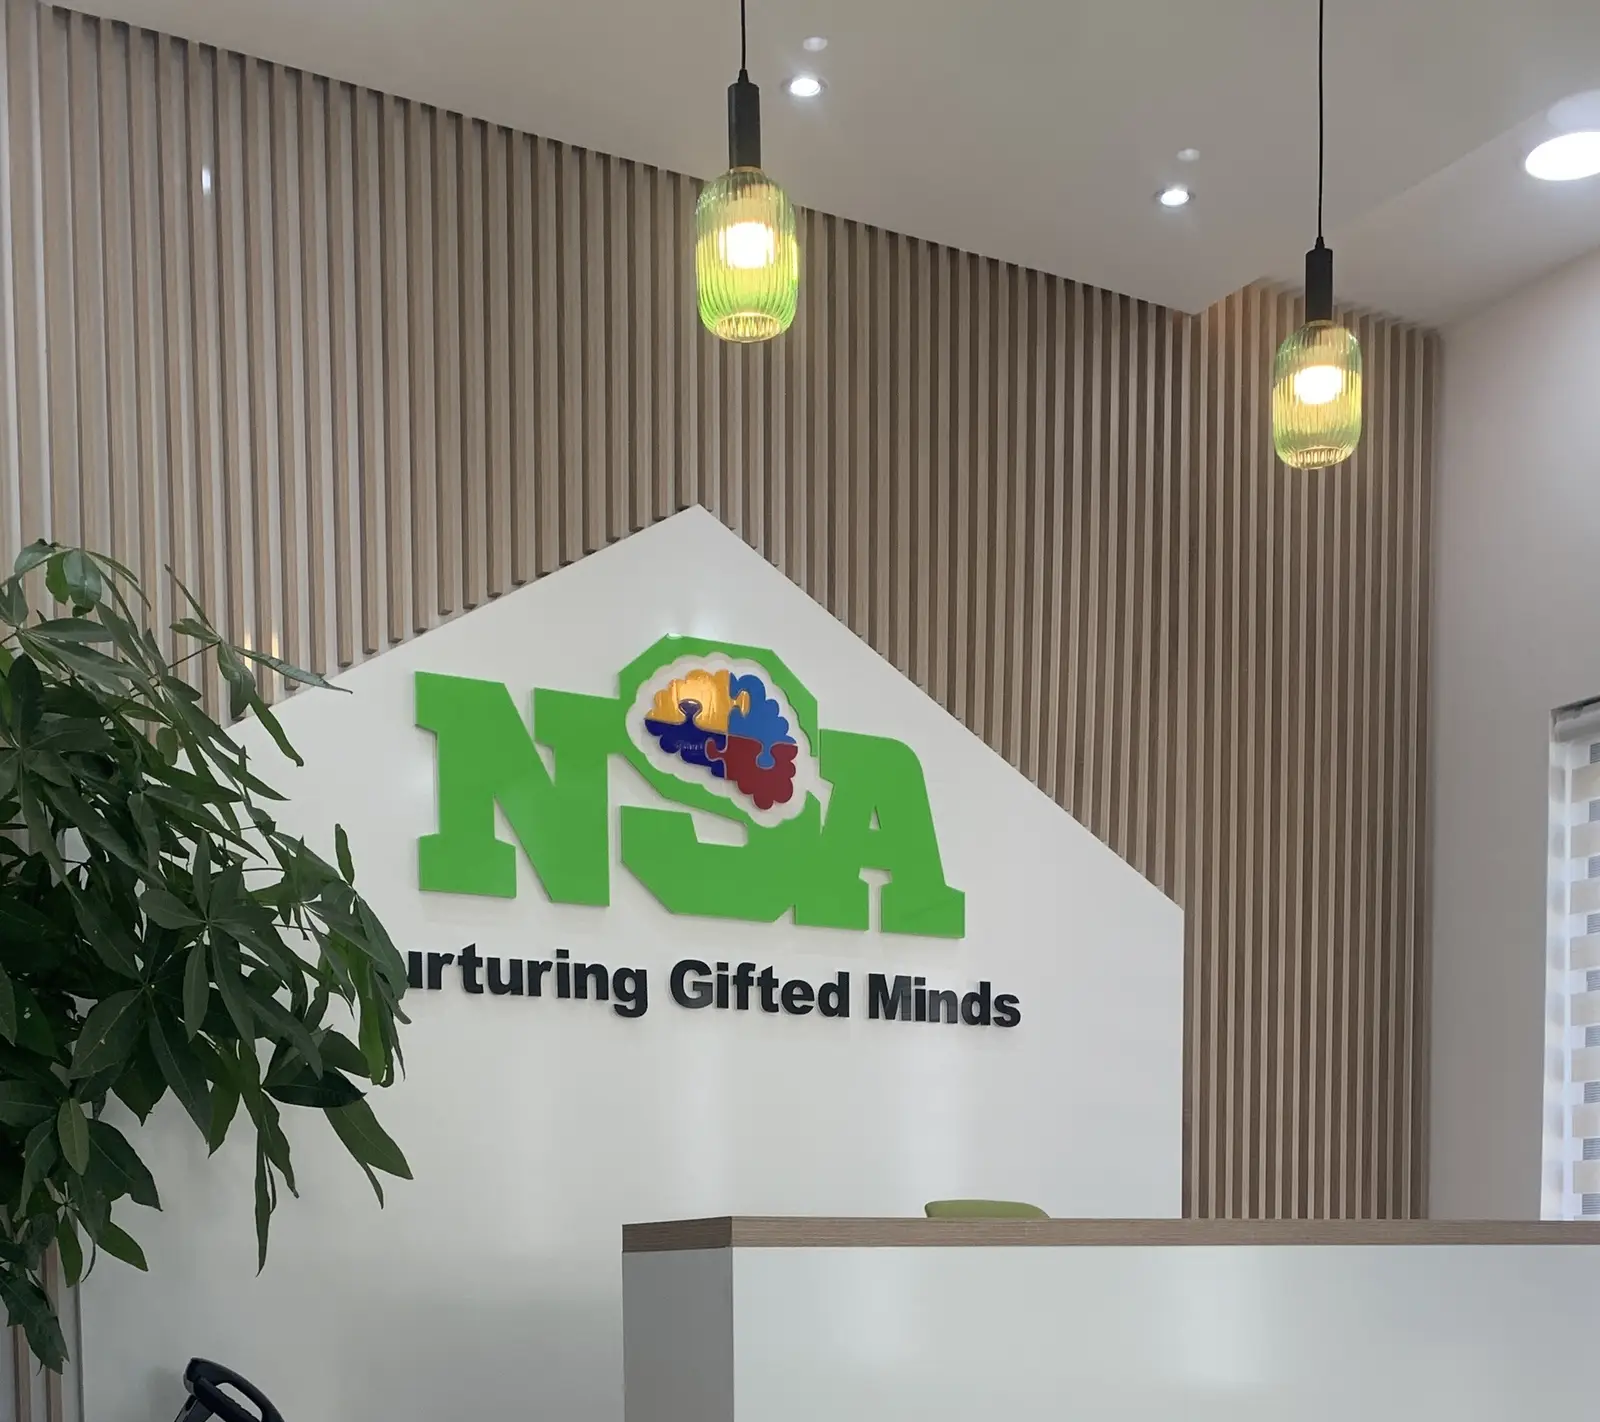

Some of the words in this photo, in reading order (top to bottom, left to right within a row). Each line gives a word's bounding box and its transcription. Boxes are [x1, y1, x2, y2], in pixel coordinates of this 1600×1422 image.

[414, 633, 965, 938] NSA
[406, 943, 649, 1018] rturing
[669, 959, 850, 1018] Gifted
[867, 973, 1022, 1028] Minds
